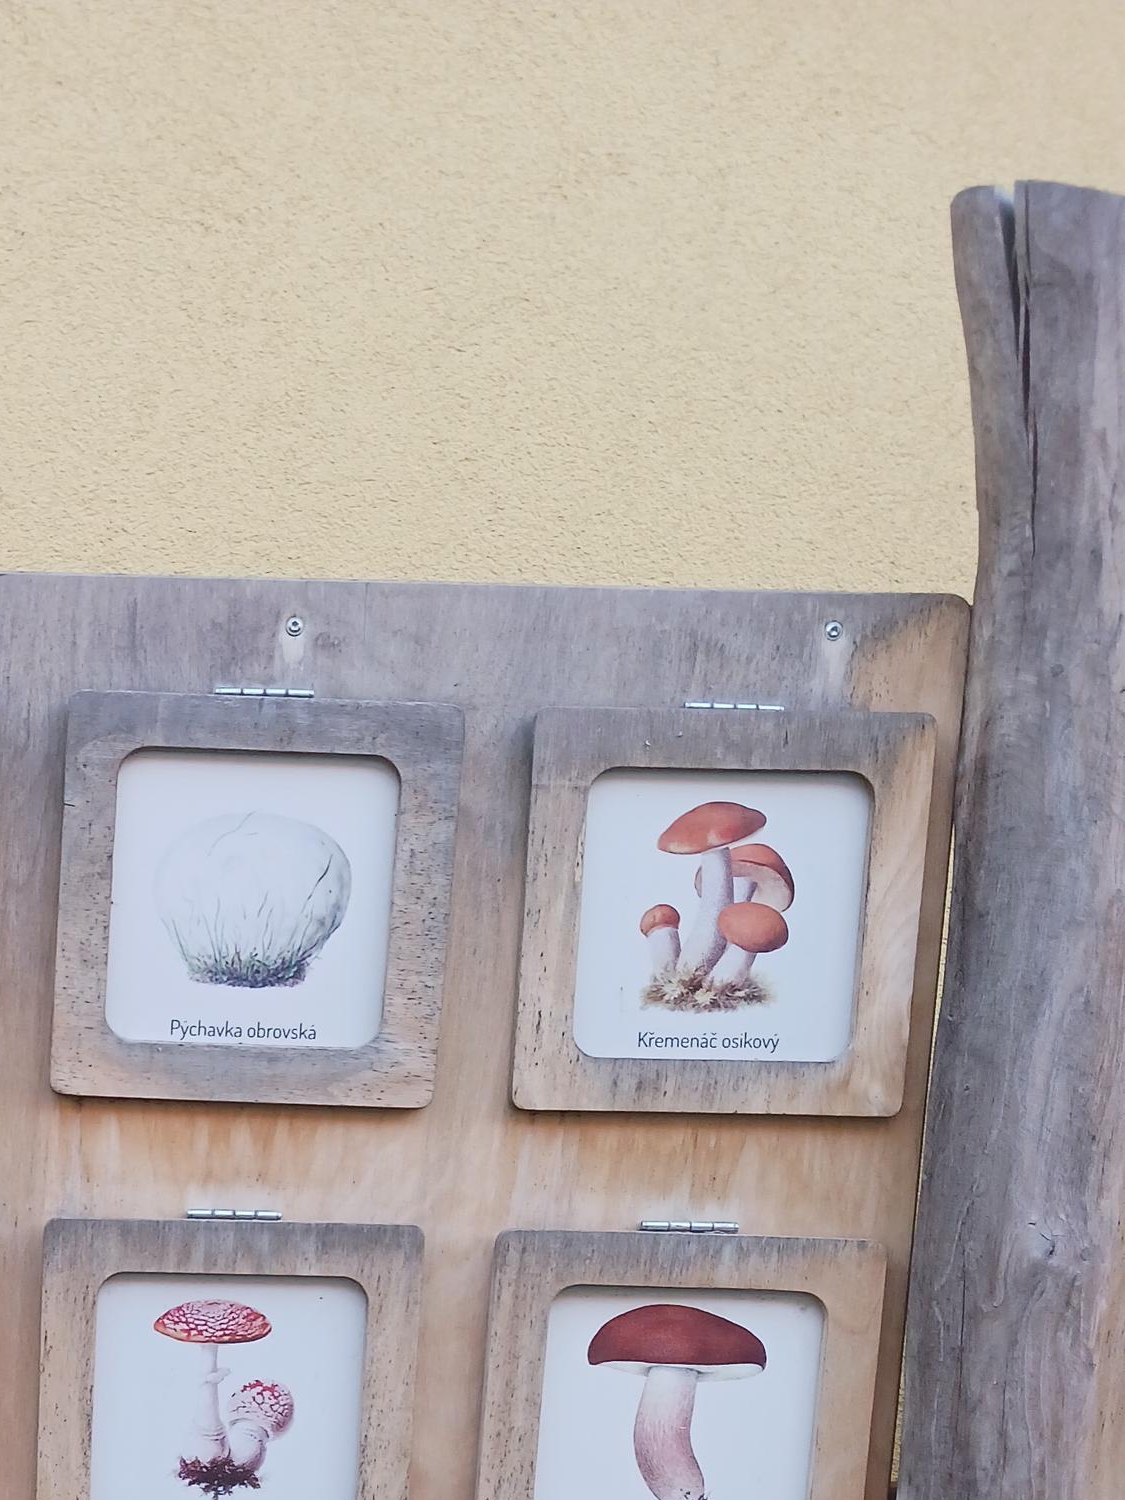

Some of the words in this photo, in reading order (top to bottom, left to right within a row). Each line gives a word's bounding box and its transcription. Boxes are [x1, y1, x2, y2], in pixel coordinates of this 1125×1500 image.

[170, 1018, 243, 1041] Pýchavka
[246, 1021, 317, 1040] obrovská
[637, 1031, 718, 1049] Křemenáč
[721, 1031, 779, 1054] osikový
